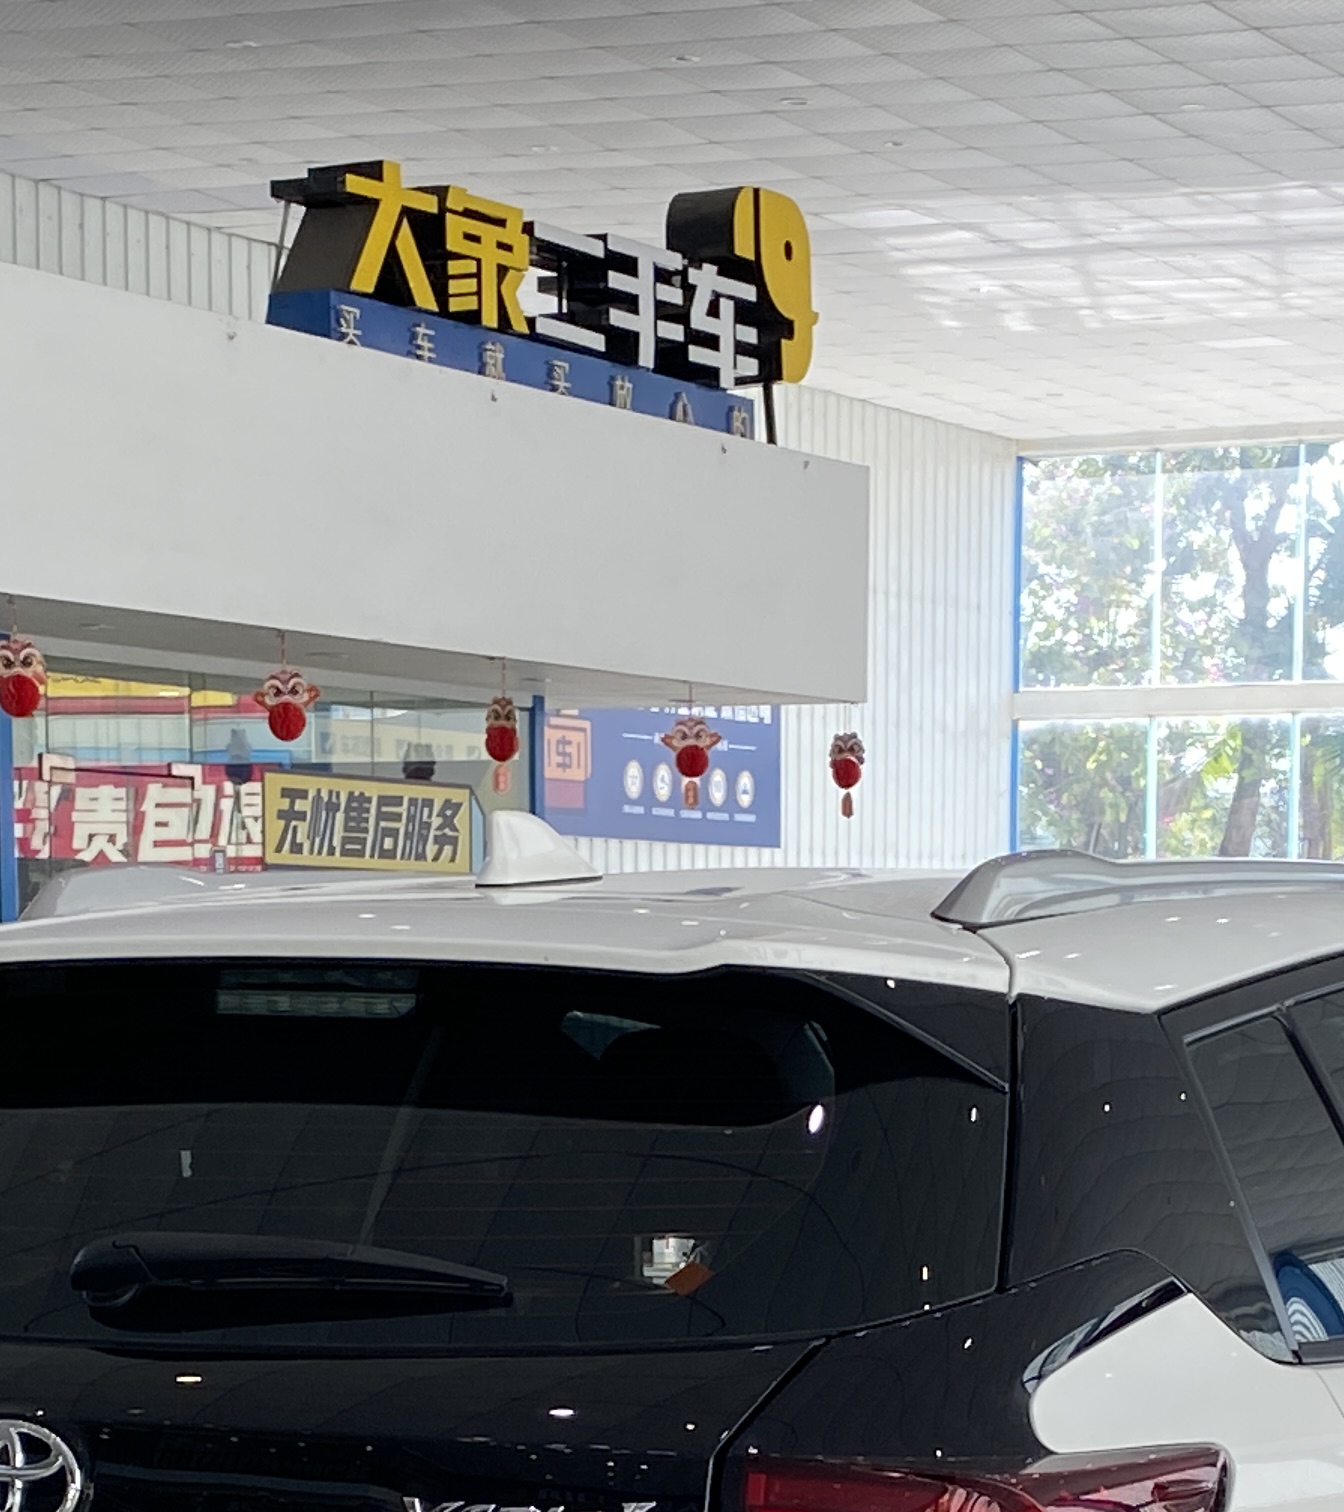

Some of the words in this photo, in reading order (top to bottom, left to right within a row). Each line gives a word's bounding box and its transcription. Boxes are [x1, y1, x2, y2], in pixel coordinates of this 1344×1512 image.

[343, 160, 758, 389] 大象二手车
[275, 786, 464, 863] 无忧售后服务
